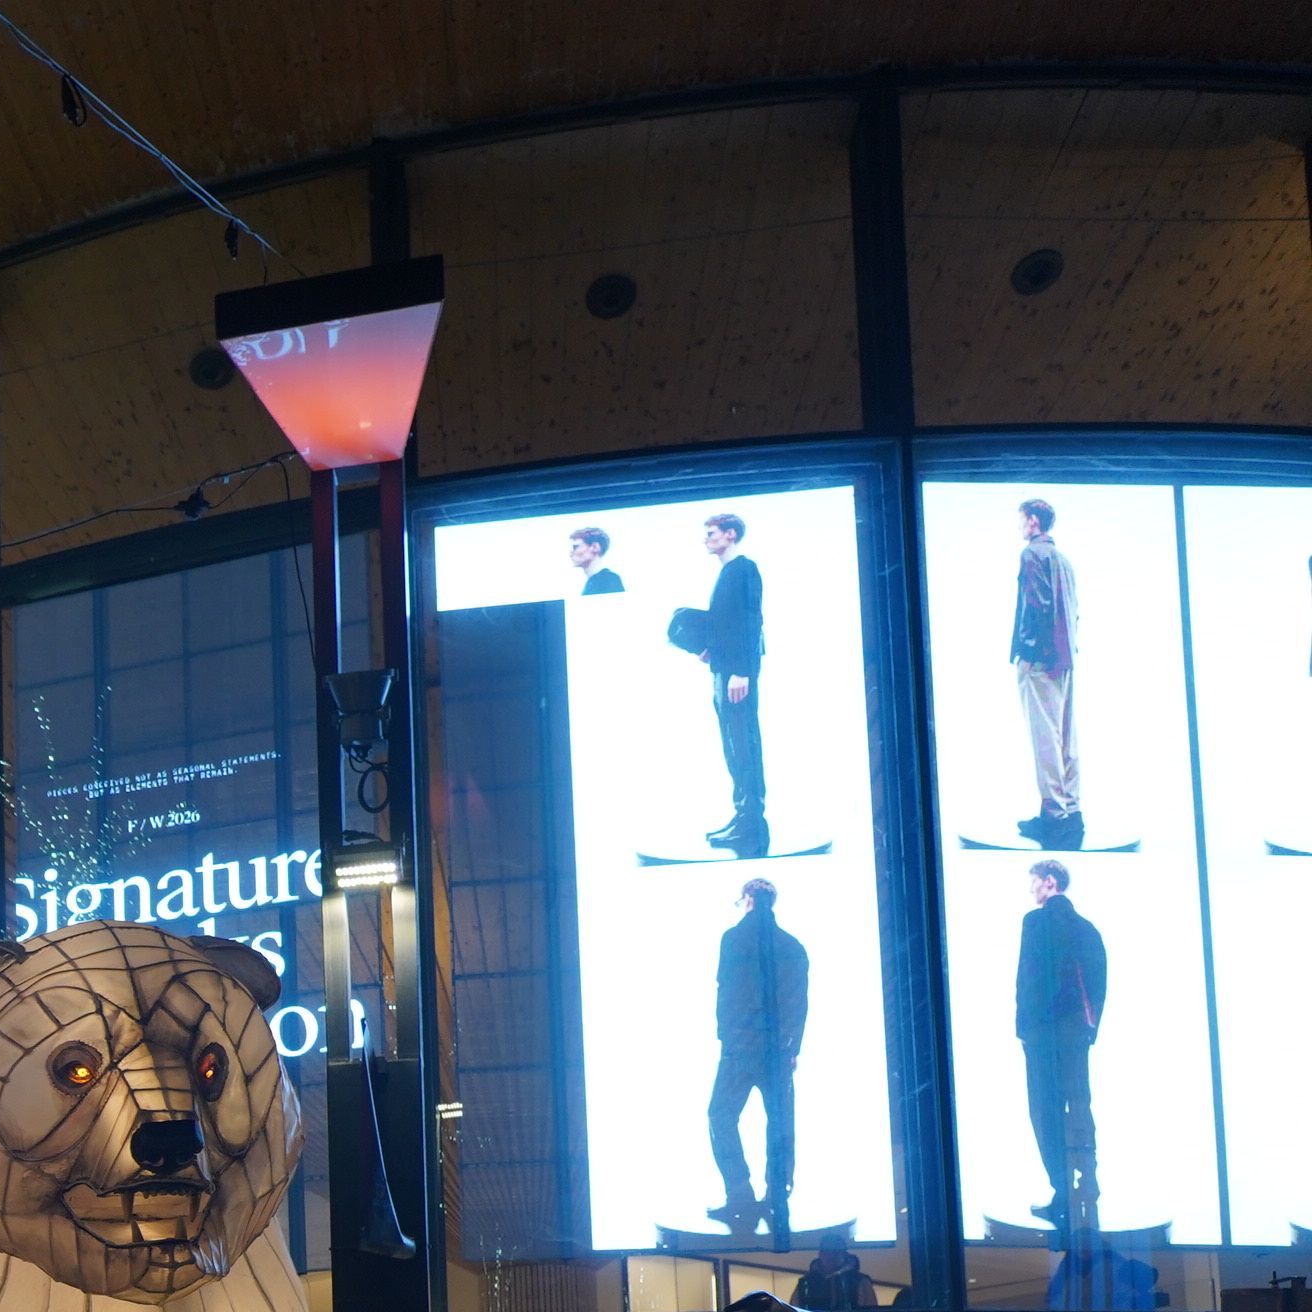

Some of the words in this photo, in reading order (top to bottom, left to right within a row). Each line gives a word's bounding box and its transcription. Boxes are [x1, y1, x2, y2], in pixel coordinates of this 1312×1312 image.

[47, 785, 78, 798] PIECES
[82, 777, 131, 792] CONCEIVED
[135, 773, 151, 783] NOT
[156, 770, 167, 778] AS
[172, 763, 216, 776] SEASONAL
[88, 788, 105, 799] BUT
[109, 786, 120, 795] AS
[125, 777, 168, 794] ELEMENTS
[173, 773, 195, 784] THAT
[200, 767, 238, 779] REMAIN.
[167, 810, 201, 827] 2026
[15, 848, 322, 943] Signature
